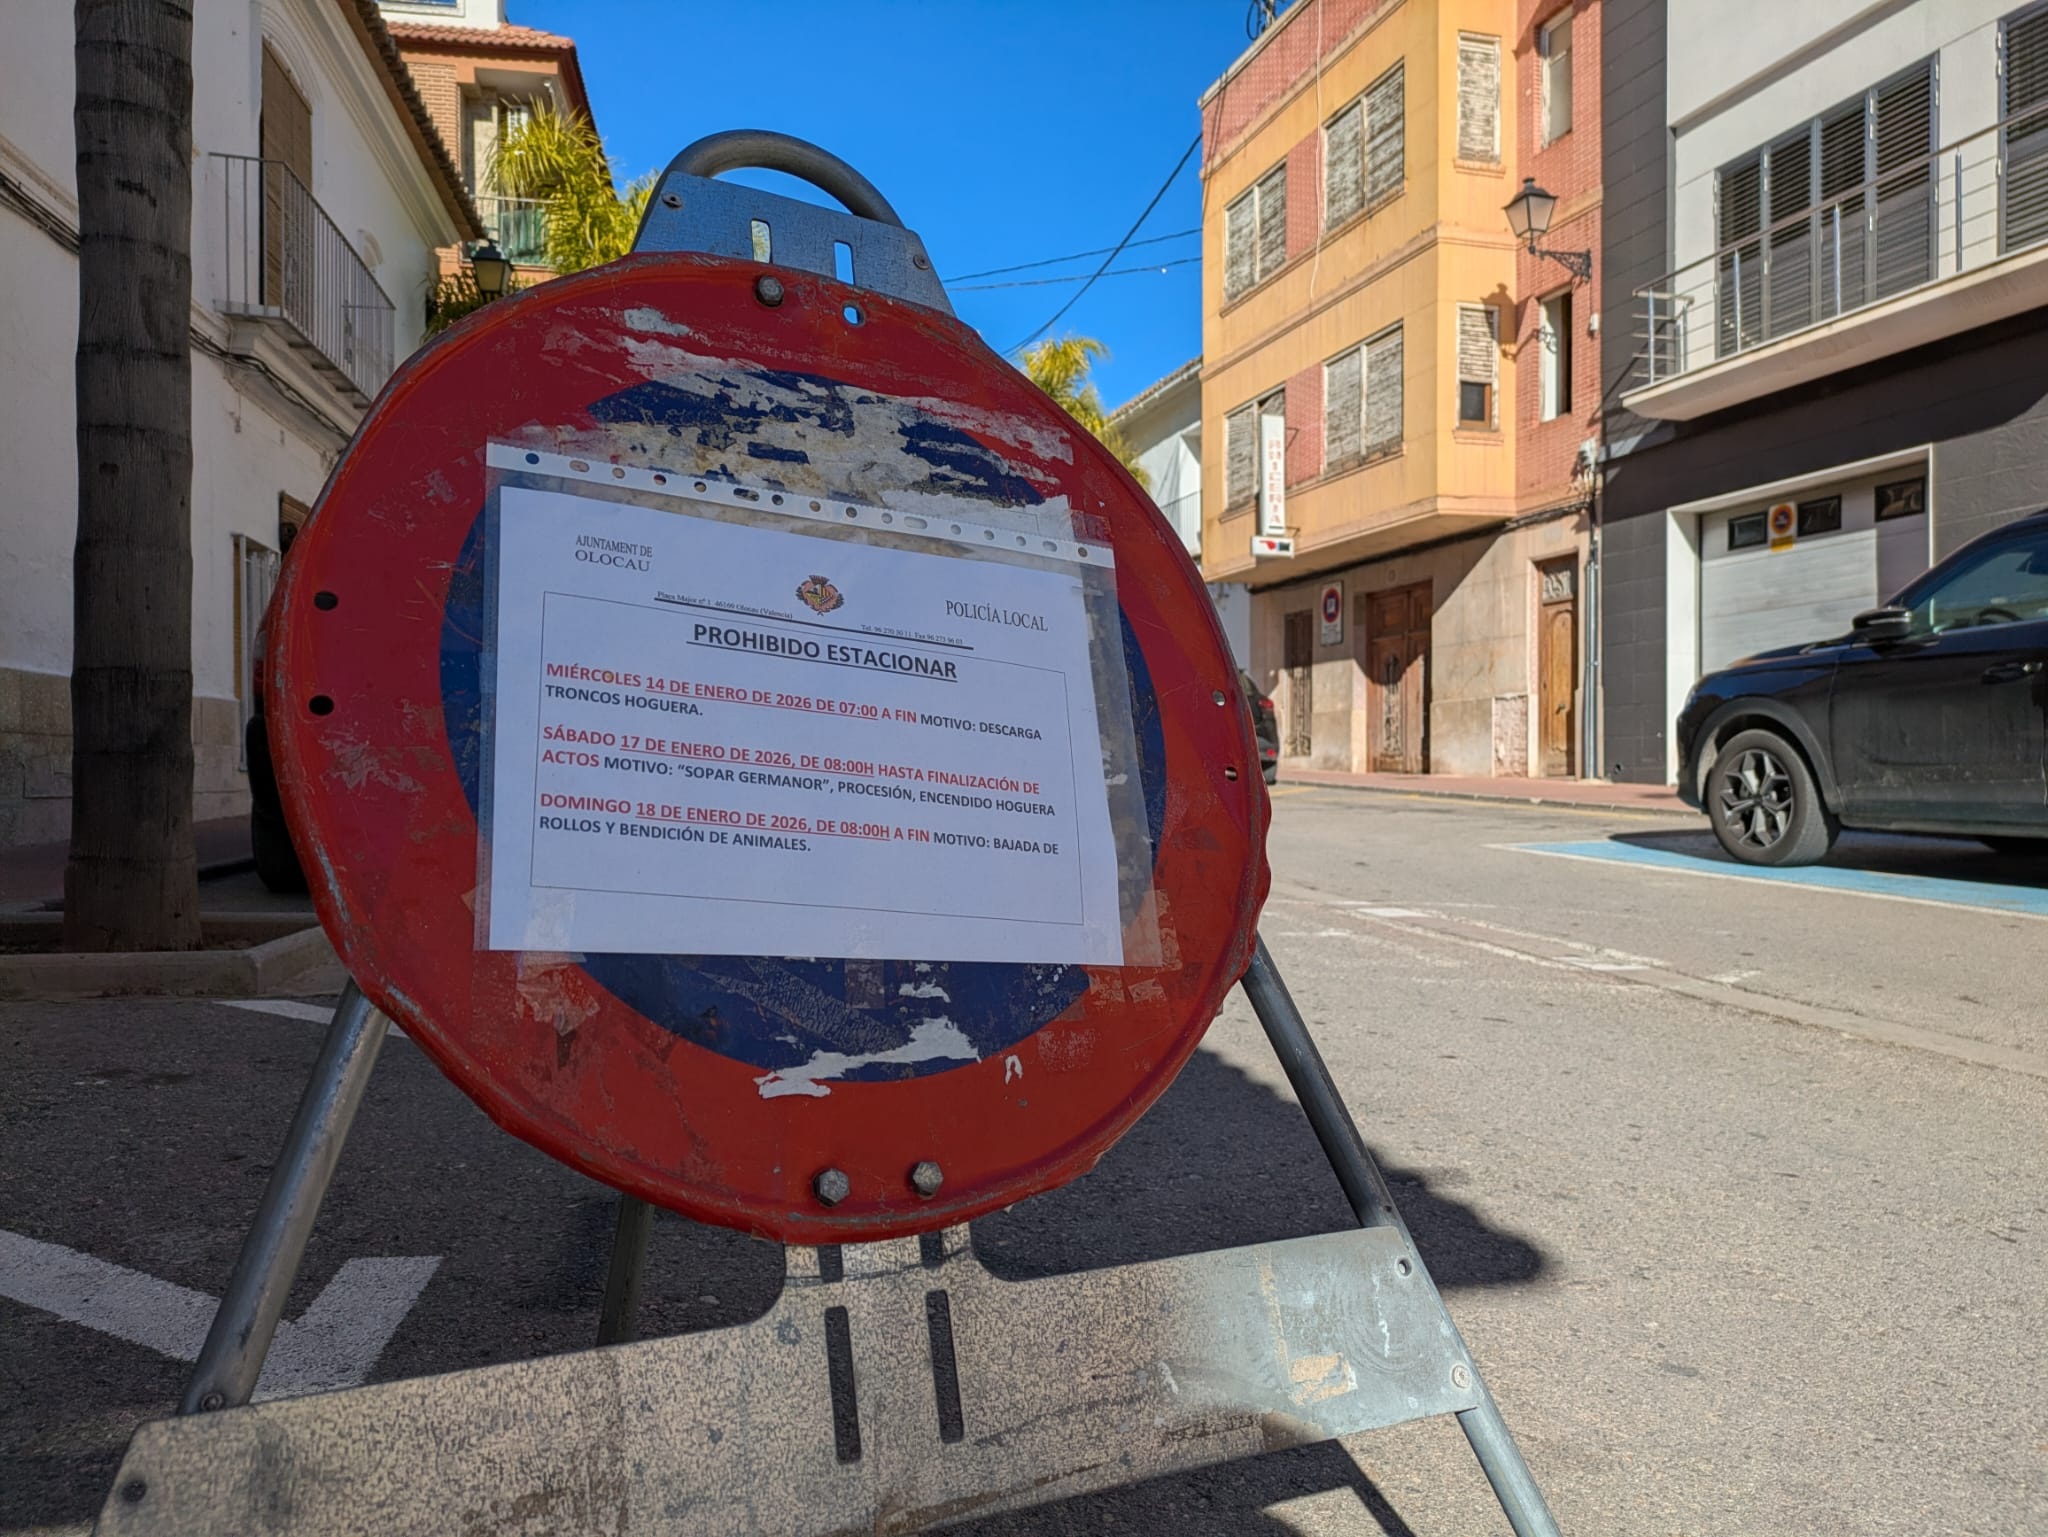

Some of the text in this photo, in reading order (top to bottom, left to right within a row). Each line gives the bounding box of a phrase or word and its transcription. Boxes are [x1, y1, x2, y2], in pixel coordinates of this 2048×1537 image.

[575, 550, 650, 571] OLOCAU
[576, 535, 653, 558] AJUNTAMENT DE
[945, 600, 1049, 632] POLICÍA LOCAL
[694, 624, 957, 679] PROHIBIDO ESTACIONAR
[545, 684, 704, 716] TRONCOS HOGUERA.
[546, 663, 1042, 741] MIÉRCOLES 14 DE ENERO DE 2026 DE 07:00 A FIN MOTIVO: DESCARGA
[543, 724, 1040, 795] SÁBADO 17 DE ENERO DE 2026, DE 08:00H HASTA FINALIZACIÓN DE
[542, 749, 1056, 816] ACTOS MOTIVO: “SOPAR GERMANOR”, PROCESIÓN, ENCENDIDO HOGUERA
[540, 793, 1059, 855] DOMINGO 18 DE ENERO DE 2026, DE 08:00H A FIN MOTIVO: BAJADA DE
[540, 816, 812, 852] ROLLOS Y BENDICIÓN DE ANIMALES.
